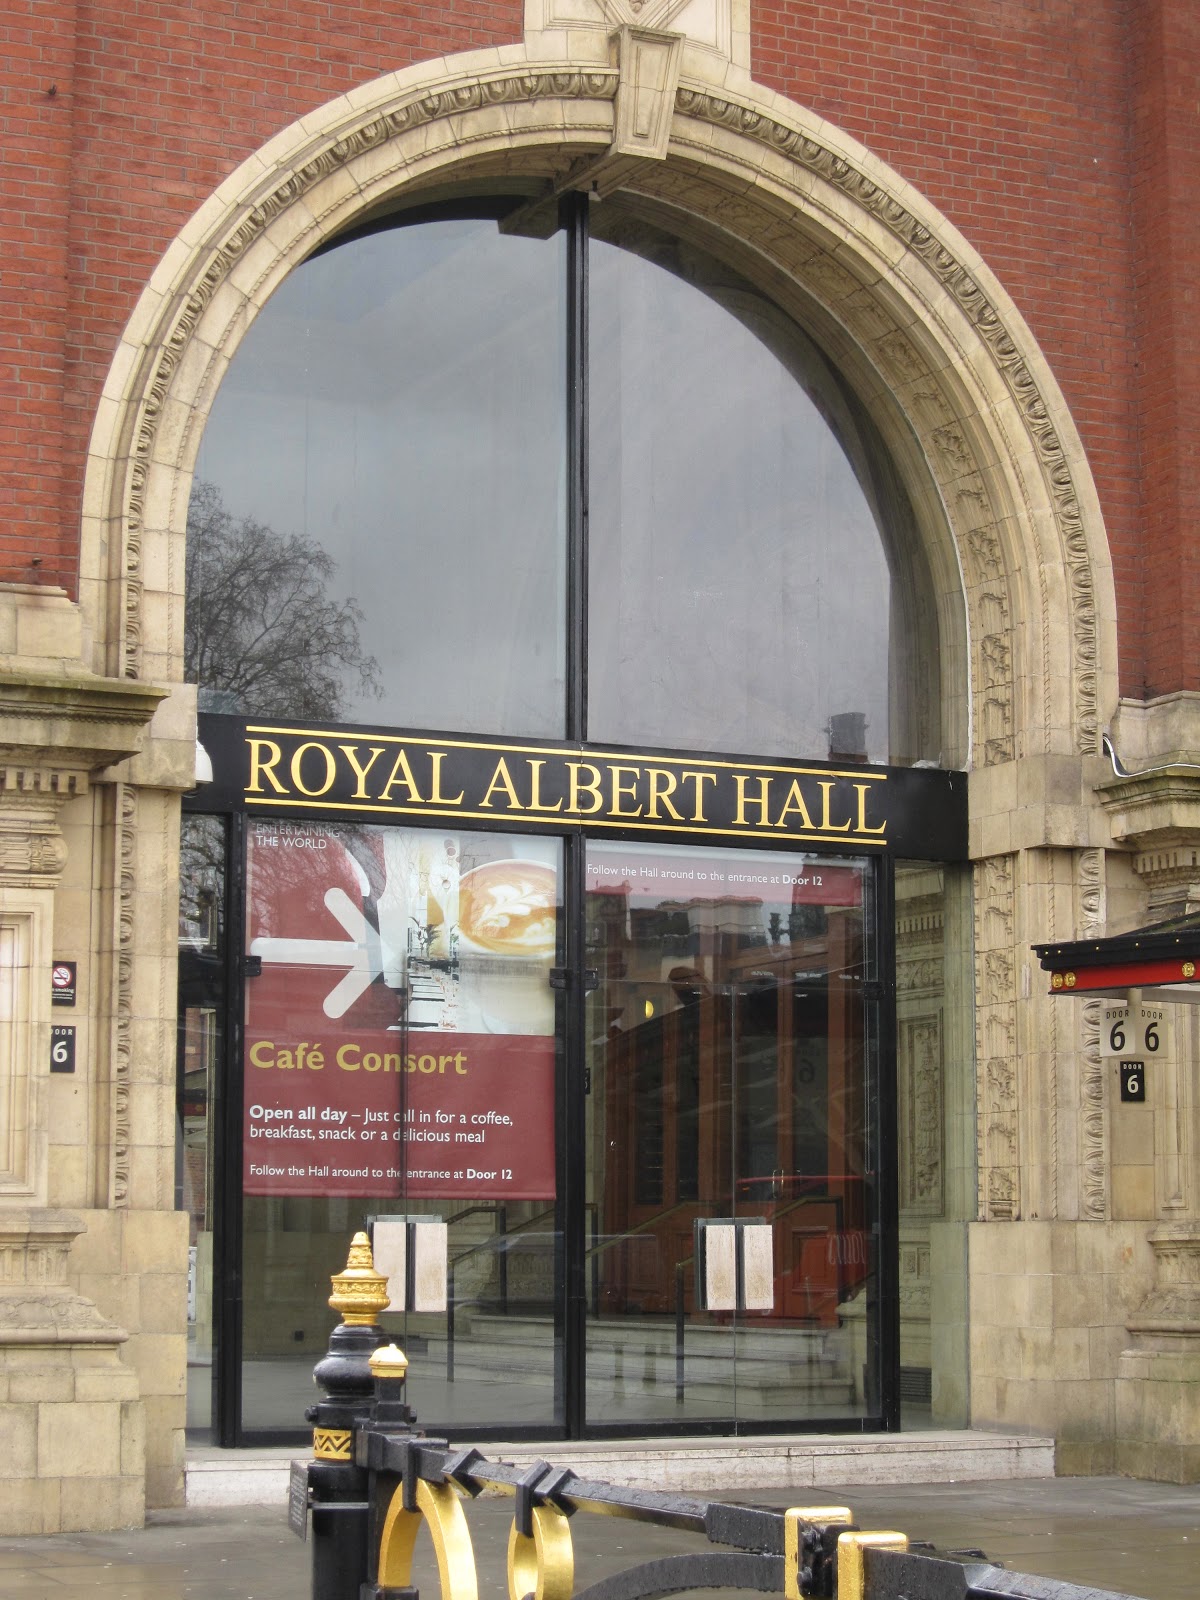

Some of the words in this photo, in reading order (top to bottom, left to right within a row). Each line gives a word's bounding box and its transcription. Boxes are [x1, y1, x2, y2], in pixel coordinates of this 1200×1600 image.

[243, 738, 465, 805] ROYAL
[478, 756, 717, 822] ALBERT
[731, 775, 887, 834] HALL
[256, 824, 339, 837] ENTERTAINING
[256, 836, 278, 846] THE
[282, 836, 327, 849] WORLD
[587, 863, 619, 876] Follow
[621, 865, 637, 876] the
[640, 867, 658, 878] Hall
[661, 868, 694, 880] around
[697, 870, 707, 880] to
[710, 869, 725, 881] the
[728, 872, 768, 883] entrance
[771, 874, 780, 884] at
[782, 874, 809, 886] Door
[812, 876, 823, 886] 12
[1106, 1010, 1129, 1019] DOOR
[1141, 1010, 1162, 1019] DOOR
[1110, 1020, 1125, 1051] 6
[1145, 1022, 1159, 1051] 6
[53, 1041, 67, 1062] 6
[249, 1040, 325, 1071] Café
[336, 1043, 468, 1075] Consort
[1128, 1075, 1138, 1093] 6
[249, 1104, 293, 1123] Open
[298, 1106, 316, 1120] all
[320, 1106, 348, 1125] day
[363, 1107, 389, 1125] Just
[419, 1110, 431, 1123] in
[435, 1109, 456, 1124] for
[459, 1114, 467, 1124] a
[471, 1110, 513, 1127] coffee,
[250, 1123, 316, 1141] breakfast,
[318, 1126, 356, 1140] snack
[360, 1130, 377, 1141] or
[380, 1131, 388, 1141] a
[455, 1129, 486, 1143] meal
[250, 1164, 285, 1176] Follow
[288, 1165, 305, 1176] the
[308, 1165, 329, 1177] Hall
[332, 1166, 369, 1177] around
[372, 1167, 383, 1178] to
[386, 1167, 402, 1178] the
[406, 1168, 451, 1179] entrance
[453, 1169, 464, 1179] at
[466, 1168, 497, 1180] Door
[501, 1169, 513, 1180] 12
